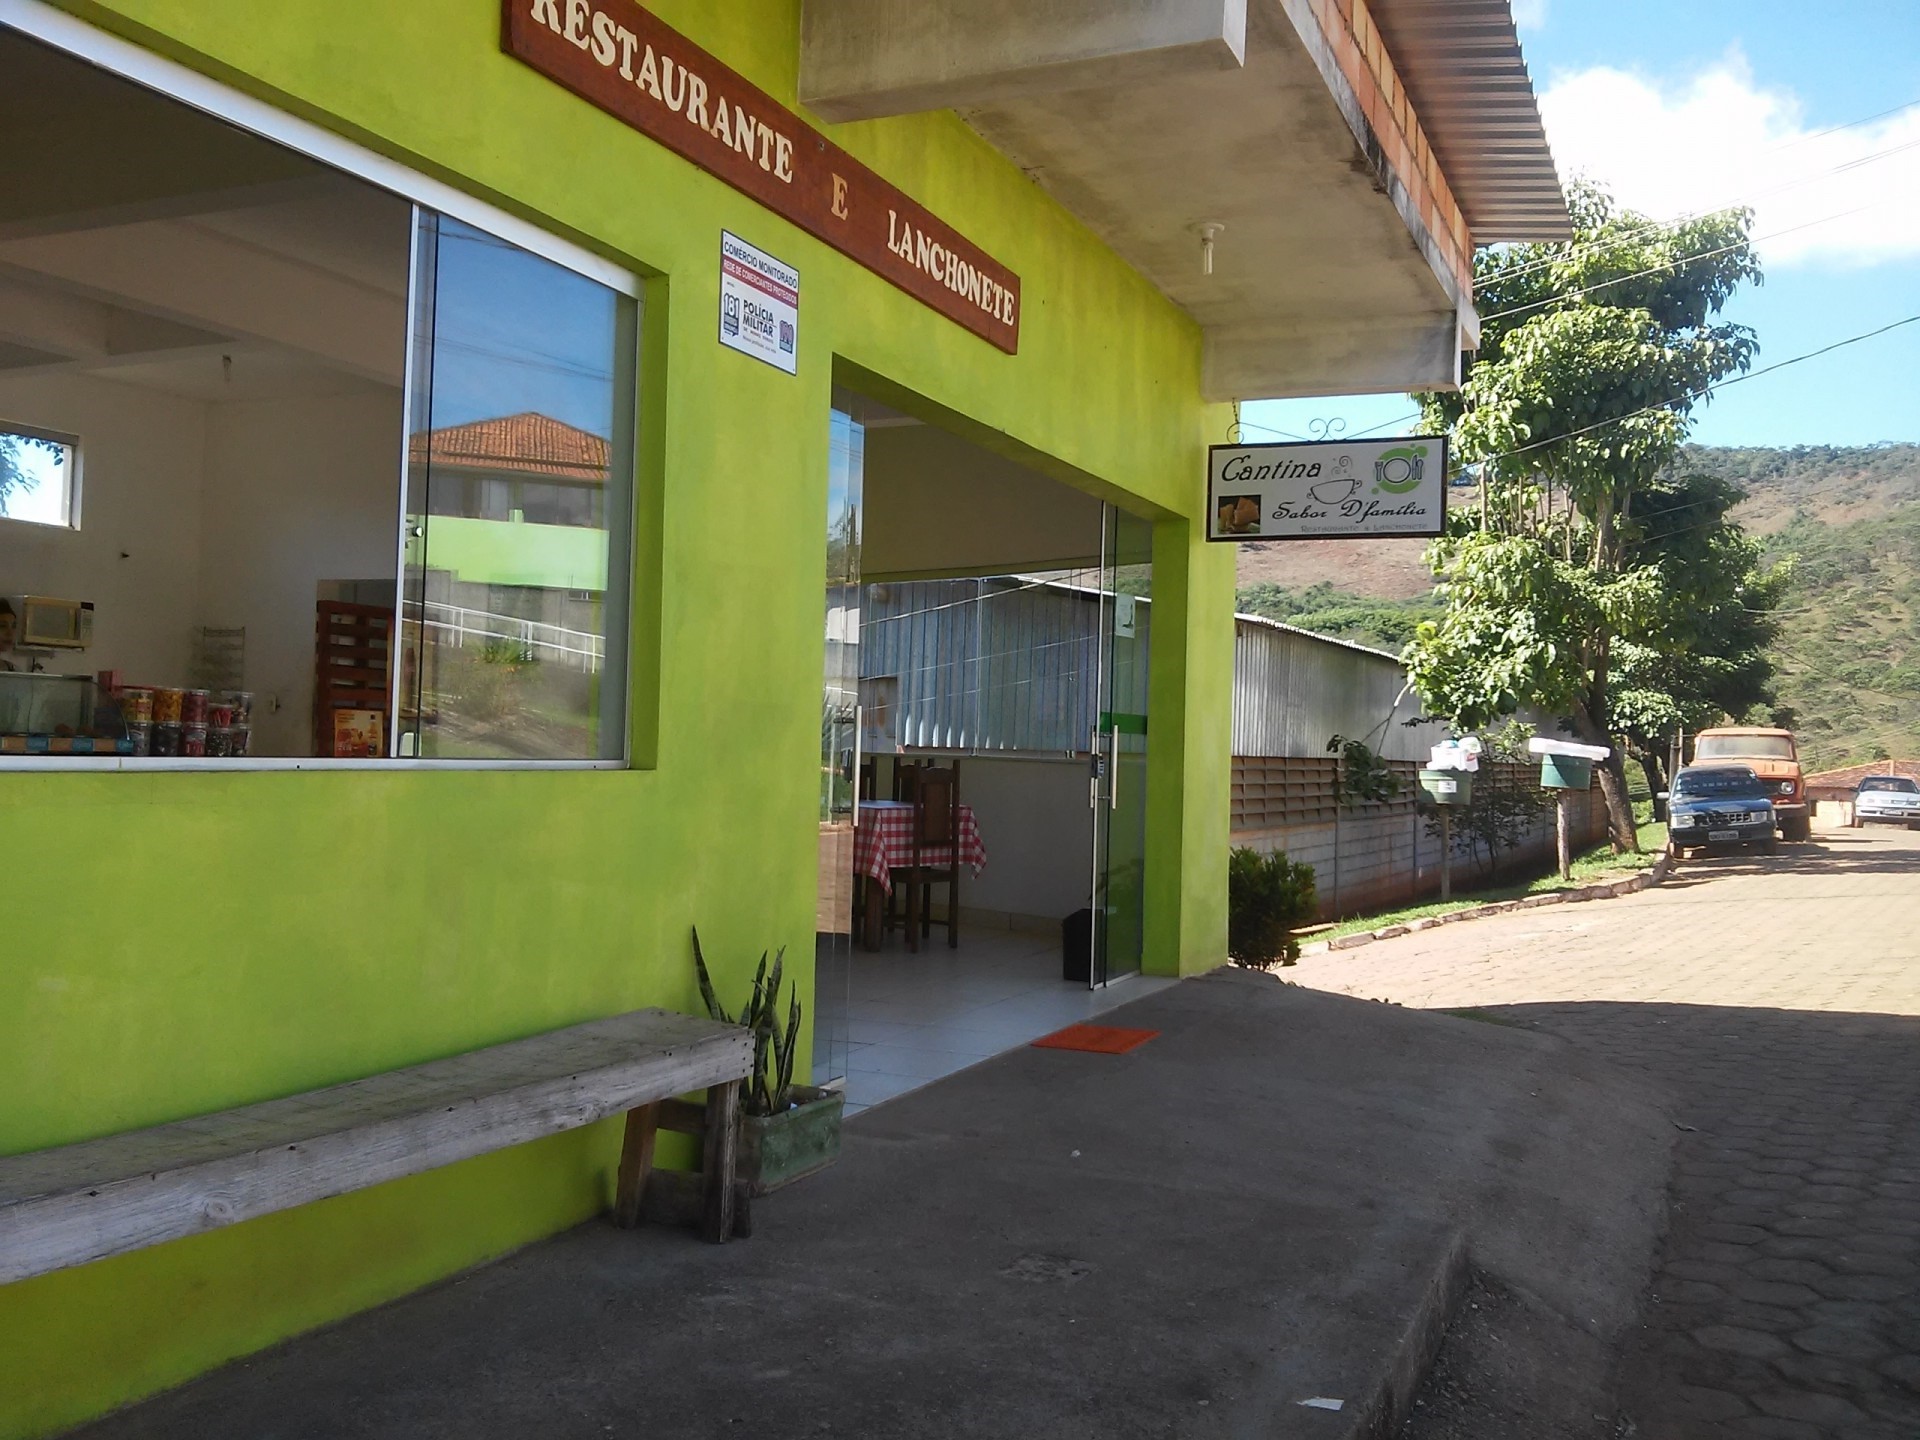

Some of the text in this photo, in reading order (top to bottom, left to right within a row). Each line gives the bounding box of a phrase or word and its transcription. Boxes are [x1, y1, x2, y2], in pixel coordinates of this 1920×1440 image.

[831, 173, 848, 221] E
[887, 209, 1015, 327] LANCHONETE
[724, 241, 798, 289] COMÉRCIO MONITORADO
[724, 293, 740, 319] 181
[744, 299, 774, 324] POLÍCIA
[743, 314, 774, 338] MILITAR
[1221, 455, 1322, 483] Cantina
[1272, 501, 1328, 520] Sabor
